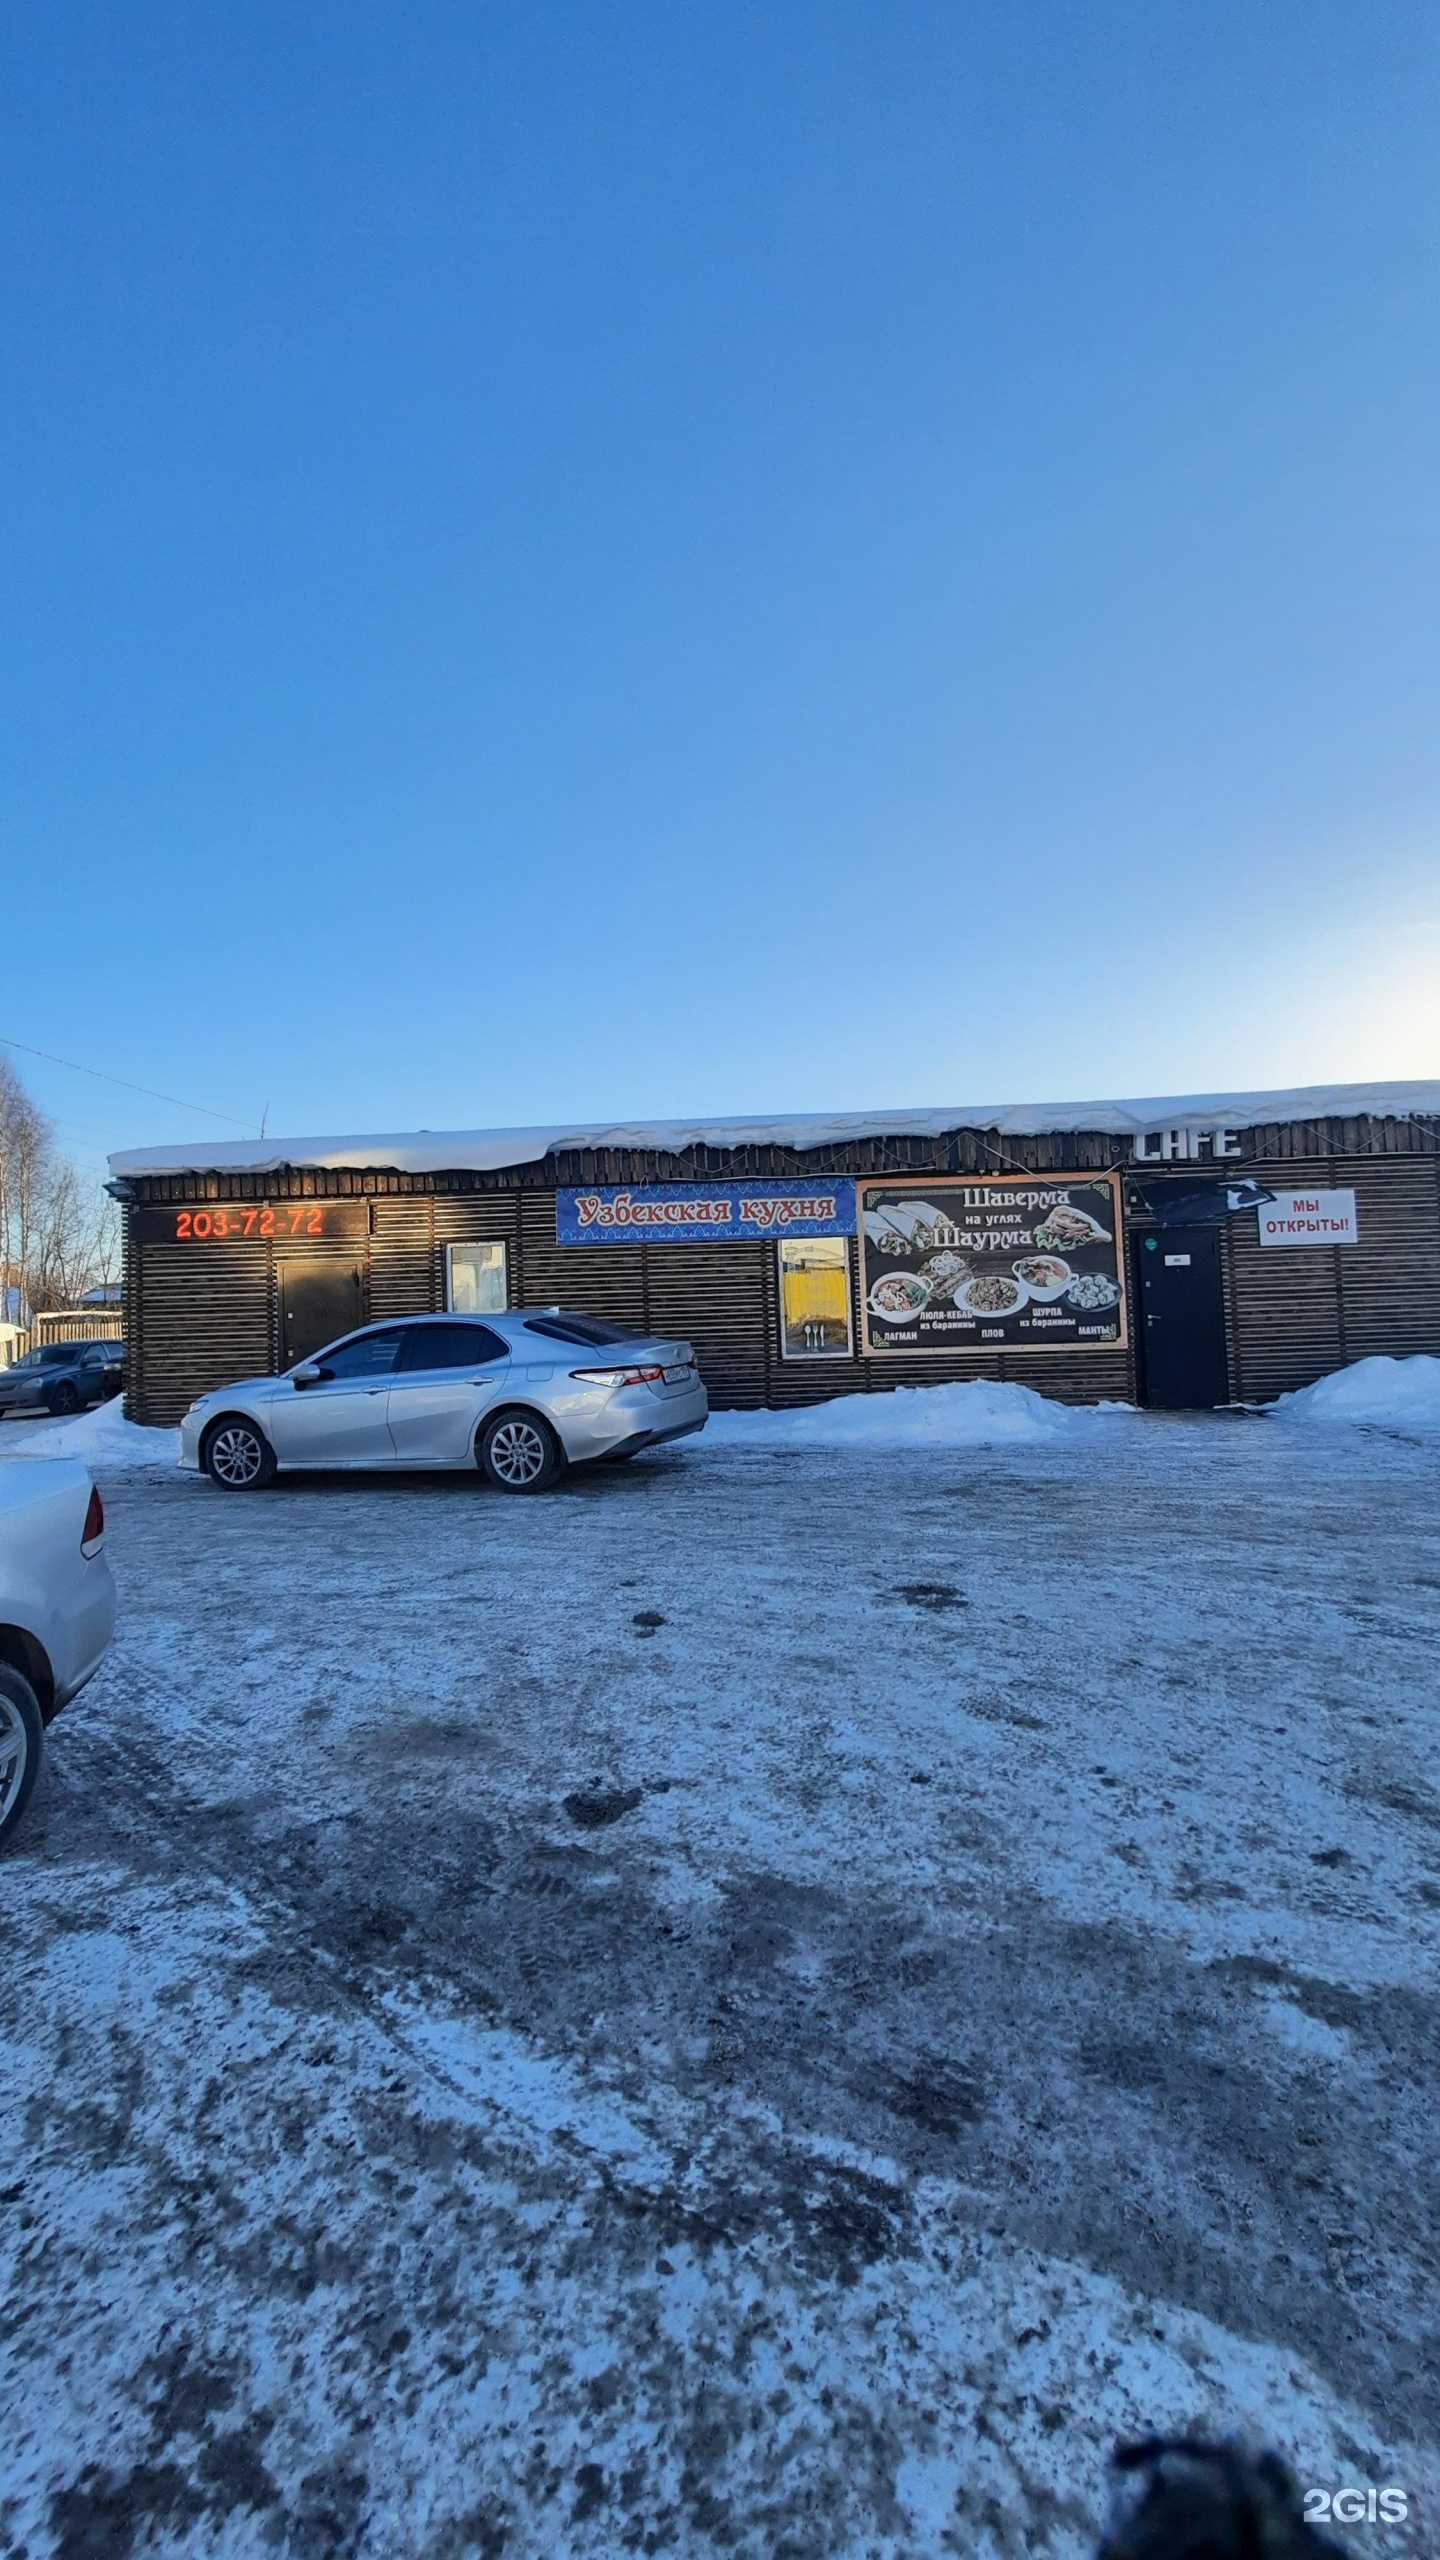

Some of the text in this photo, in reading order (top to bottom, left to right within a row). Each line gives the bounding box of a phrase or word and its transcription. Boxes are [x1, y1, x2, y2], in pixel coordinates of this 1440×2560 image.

[963, 1187, 1071, 1211] Шаверма
[1292, 1199, 1320, 1213] МЫ
[576, 1192, 836, 1229] Узбекская кухня
[176, 1208, 324, 1238] 203-72-72
[965, 1213, 1022, 1227] на углях
[1266, 1216, 1350, 1234] ОТКРЫТЫ!
[932, 1225, 1033, 1251] Шаурма
[1032, 1307, 1062, 1317] ШУРПА
[920, 1320, 976, 1331] из баранины
[1019, 1317, 1076, 1329] из баранины
[1078, 1325, 1110, 1335] МАНТЫ
[884, 1331, 918, 1341] ЛАГМАН
[981, 1328, 1005, 1338] ПЛОВ
